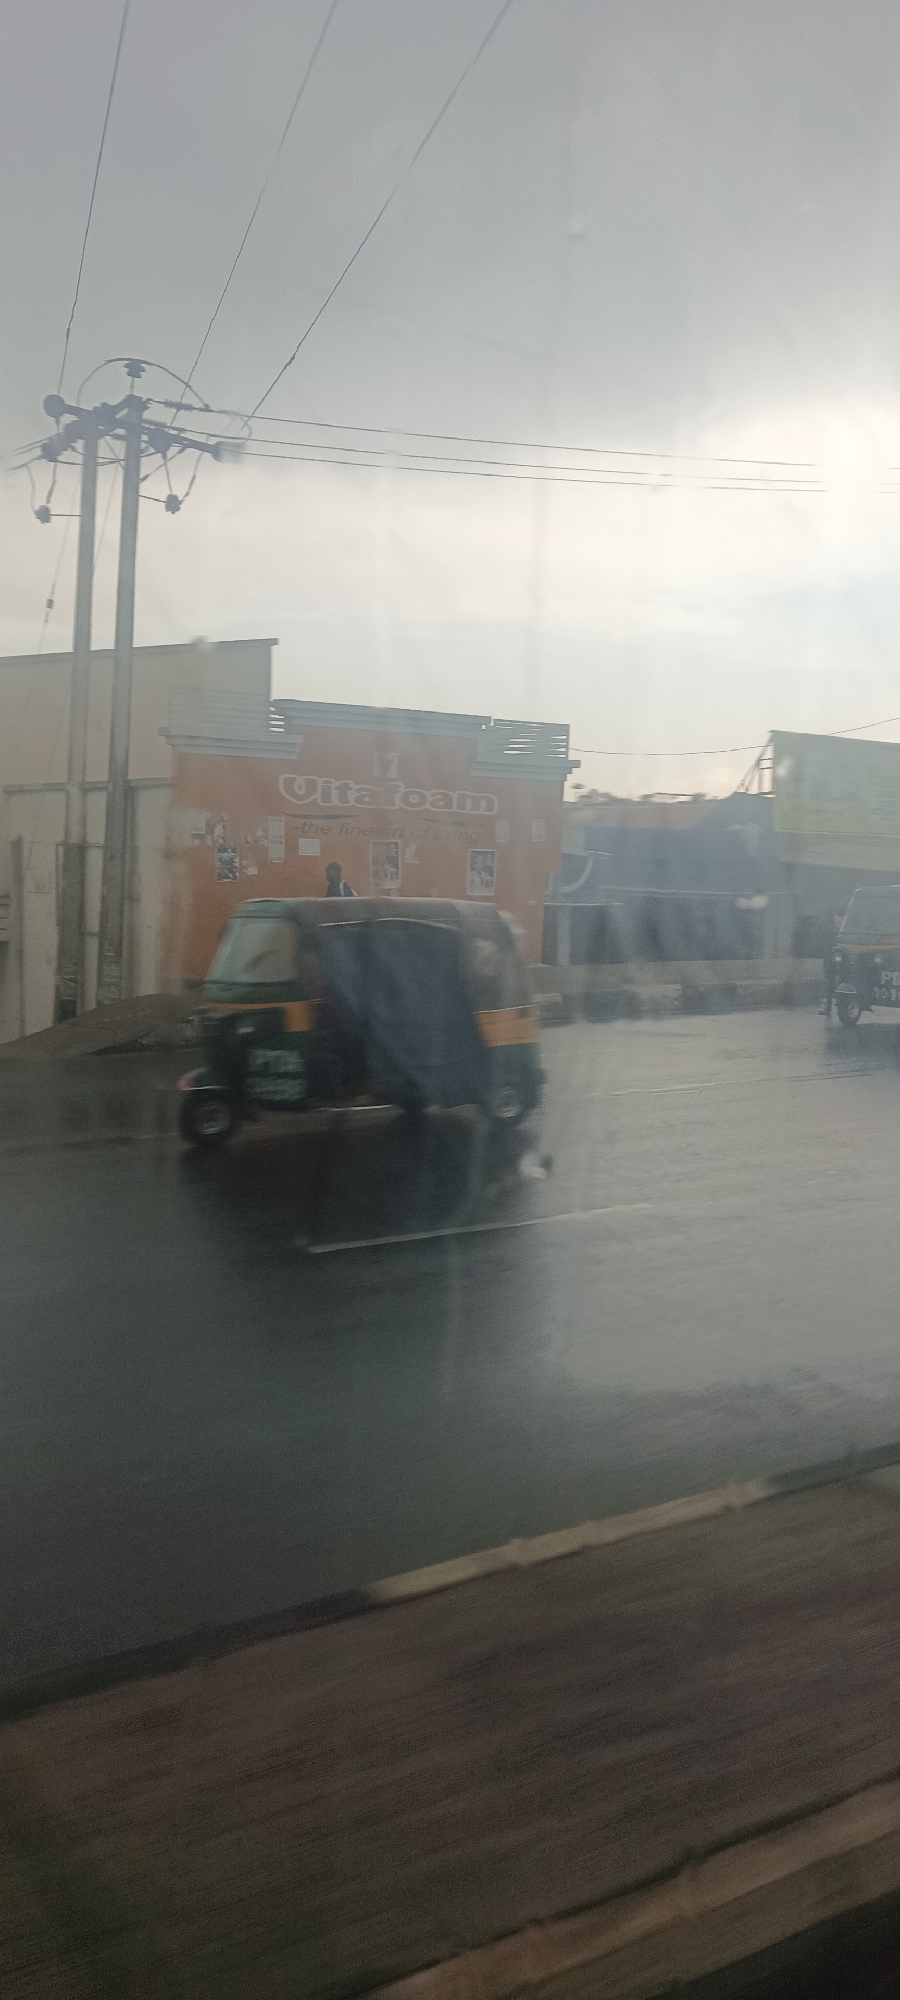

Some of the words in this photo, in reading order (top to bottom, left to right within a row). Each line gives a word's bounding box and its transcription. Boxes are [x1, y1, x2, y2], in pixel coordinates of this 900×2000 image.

[278, 774, 498, 814] Vitafoam
[339, 822, 374, 838] fine
[383, 824, 406, 839] art
[411, 825, 430, 840] of
